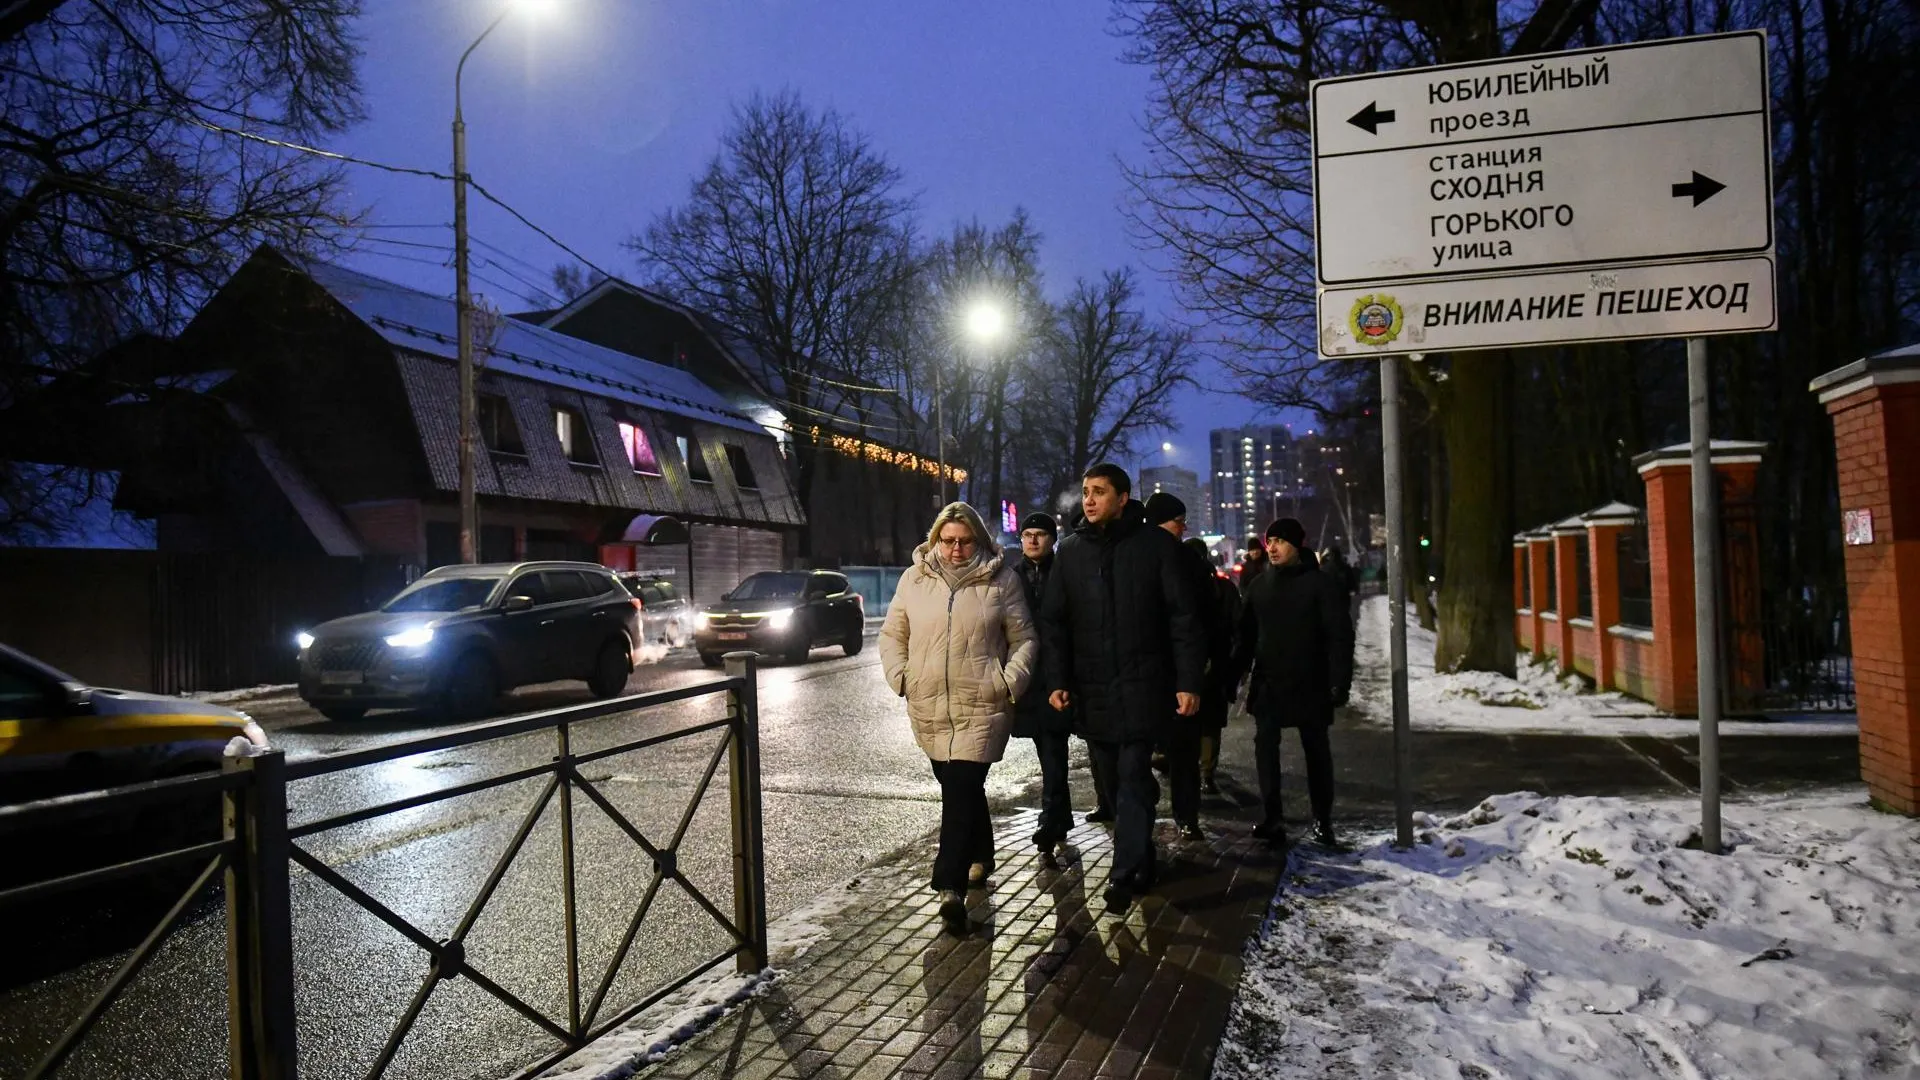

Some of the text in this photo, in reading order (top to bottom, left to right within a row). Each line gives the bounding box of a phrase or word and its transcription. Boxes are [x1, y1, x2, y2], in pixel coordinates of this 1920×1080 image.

[1428, 56, 1609, 105] ЮБИЛЕЙНЫЙ
[1430, 108, 1530, 138] проезд
[1429, 147, 1542, 172] станция
[1430, 170, 1544, 201] СХОДНЯ
[1431, 204, 1574, 237] ГОРЬКОГО
[1432, 239, 1513, 267] улица
[1423, 282, 1750, 328] ВНИМАНИЕ ПЕШЕХОД
